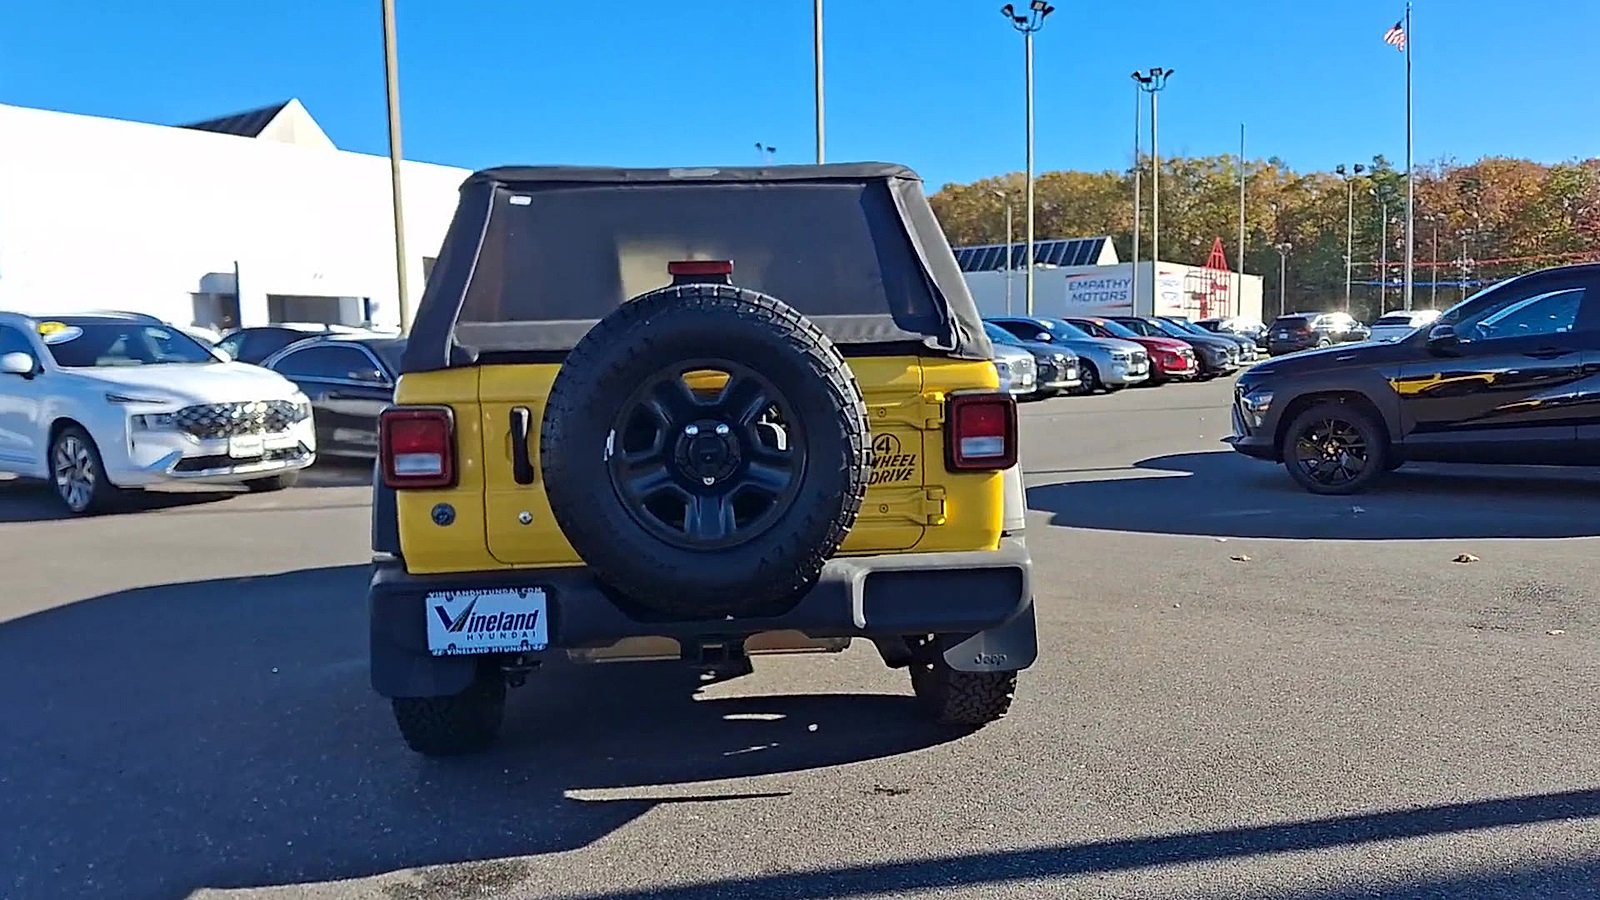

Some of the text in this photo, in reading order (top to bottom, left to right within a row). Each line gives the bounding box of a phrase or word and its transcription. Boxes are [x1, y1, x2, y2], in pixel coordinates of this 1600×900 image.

[1068, 279, 1131, 291] EMPATHY
[1072, 291, 1127, 302] MOTORS
[876, 436, 891, 454] 4
[870, 454, 916, 469] WHEEL
[867, 468, 914, 485] DRIVE
[429, 587, 542, 598] VINELANDHYUNDAI.COM
[434, 594, 540, 633] Vineland
[467, 631, 536, 641] HYUNDAI
[447, 645, 531, 656] VINELAND HYUNDAI
[974, 652, 1007, 666] Jeep
